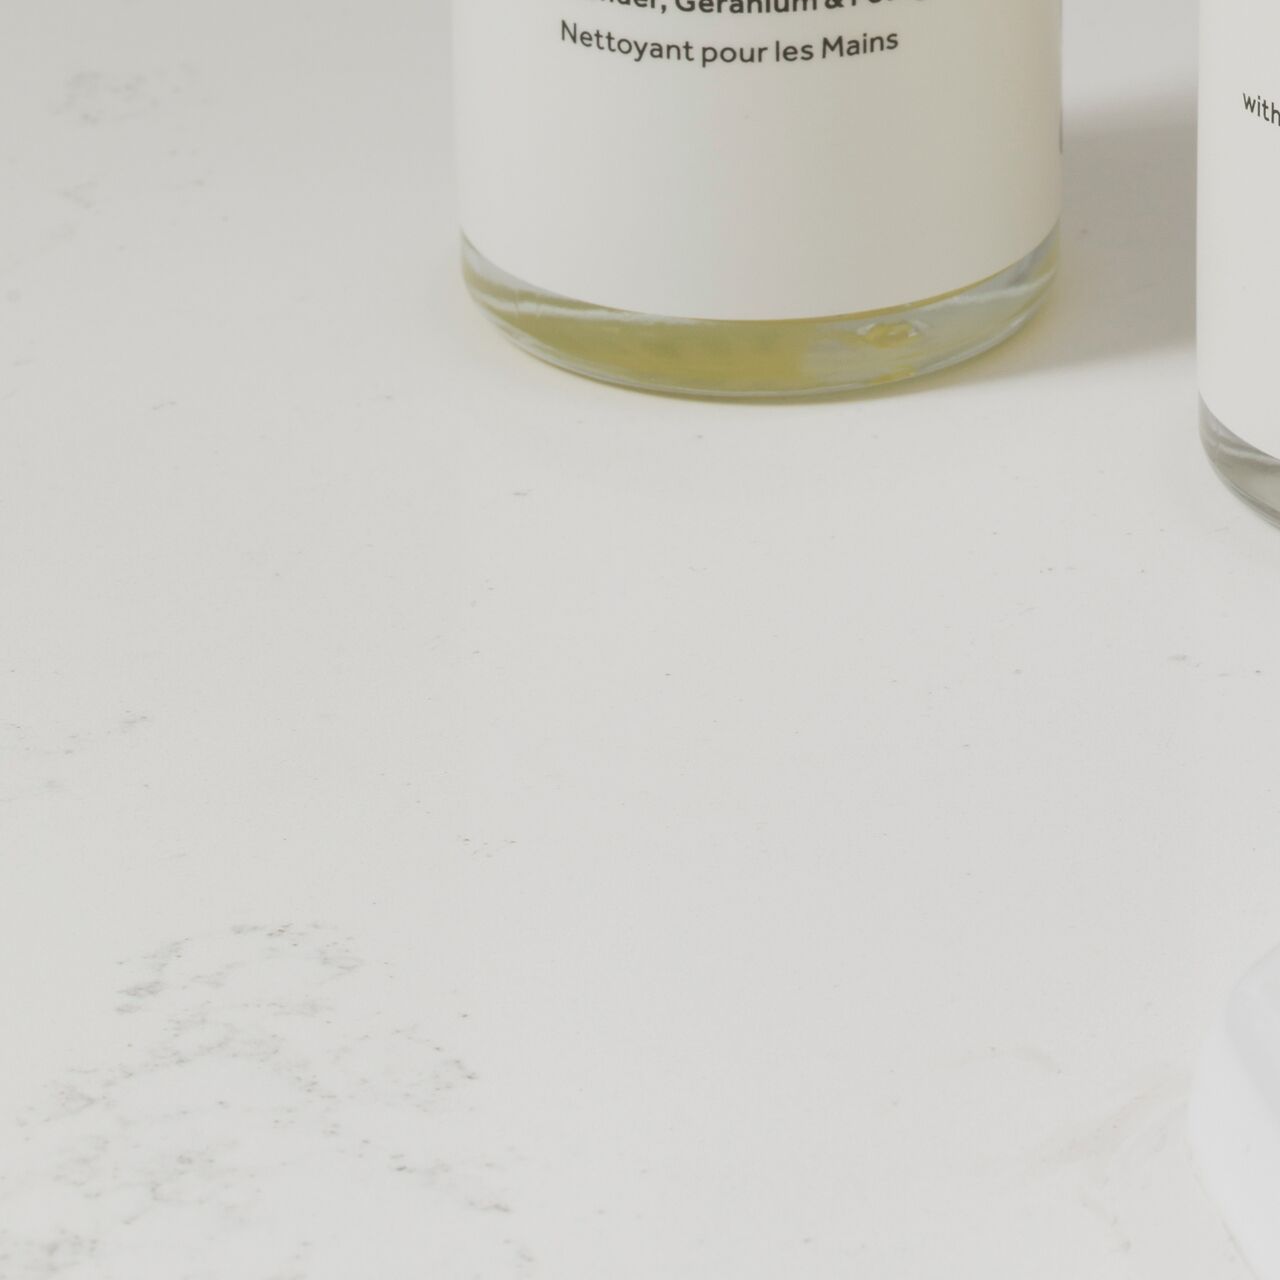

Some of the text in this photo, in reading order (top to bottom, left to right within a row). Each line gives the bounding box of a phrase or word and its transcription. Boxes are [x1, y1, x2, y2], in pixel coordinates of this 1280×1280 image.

[560, 19, 899, 69] Nettoyant pour les Mains
